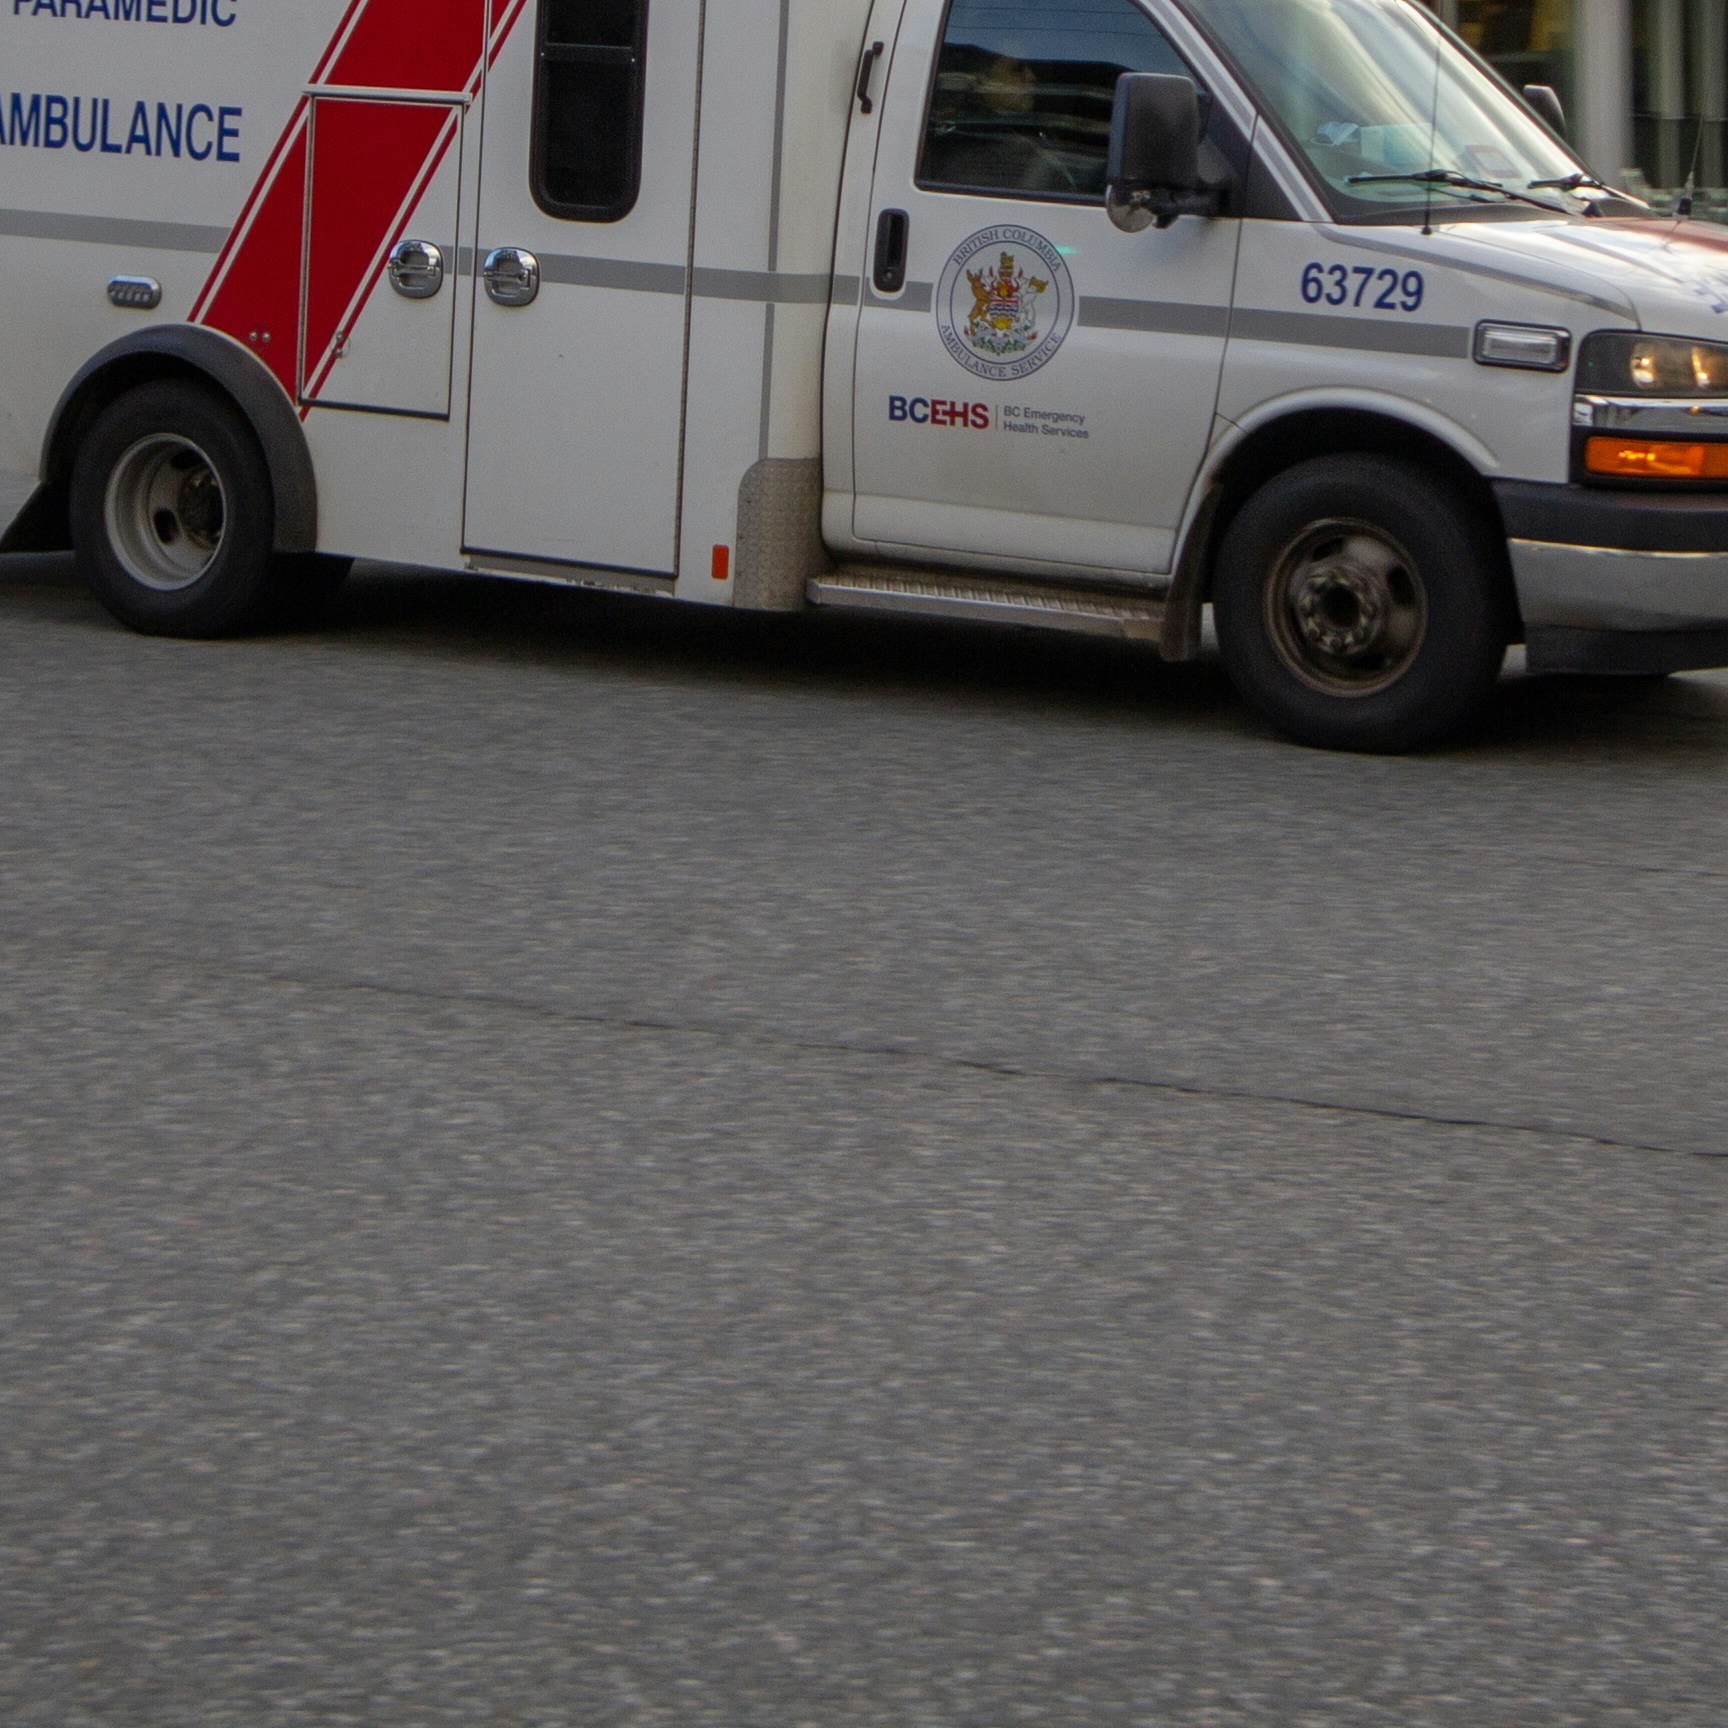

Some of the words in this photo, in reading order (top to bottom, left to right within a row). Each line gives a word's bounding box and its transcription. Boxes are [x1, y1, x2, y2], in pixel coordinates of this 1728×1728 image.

[952, 229, 1000, 267] BRITISH
[1002, 227, 1063, 273] COLUMBIA
[1301, 261, 1424, 312] 63729
[941, 323, 1007, 378] AMBULANCE
[1010, 332, 1062, 376] SERVICE
[888, 395, 990, 430] BCEHS
[1003, 405, 1021, 418] BC
[1023, 406, 1085, 426] Emergency
[1003, 420, 1039, 434] Health
[1041, 423, 1090, 439] Services
